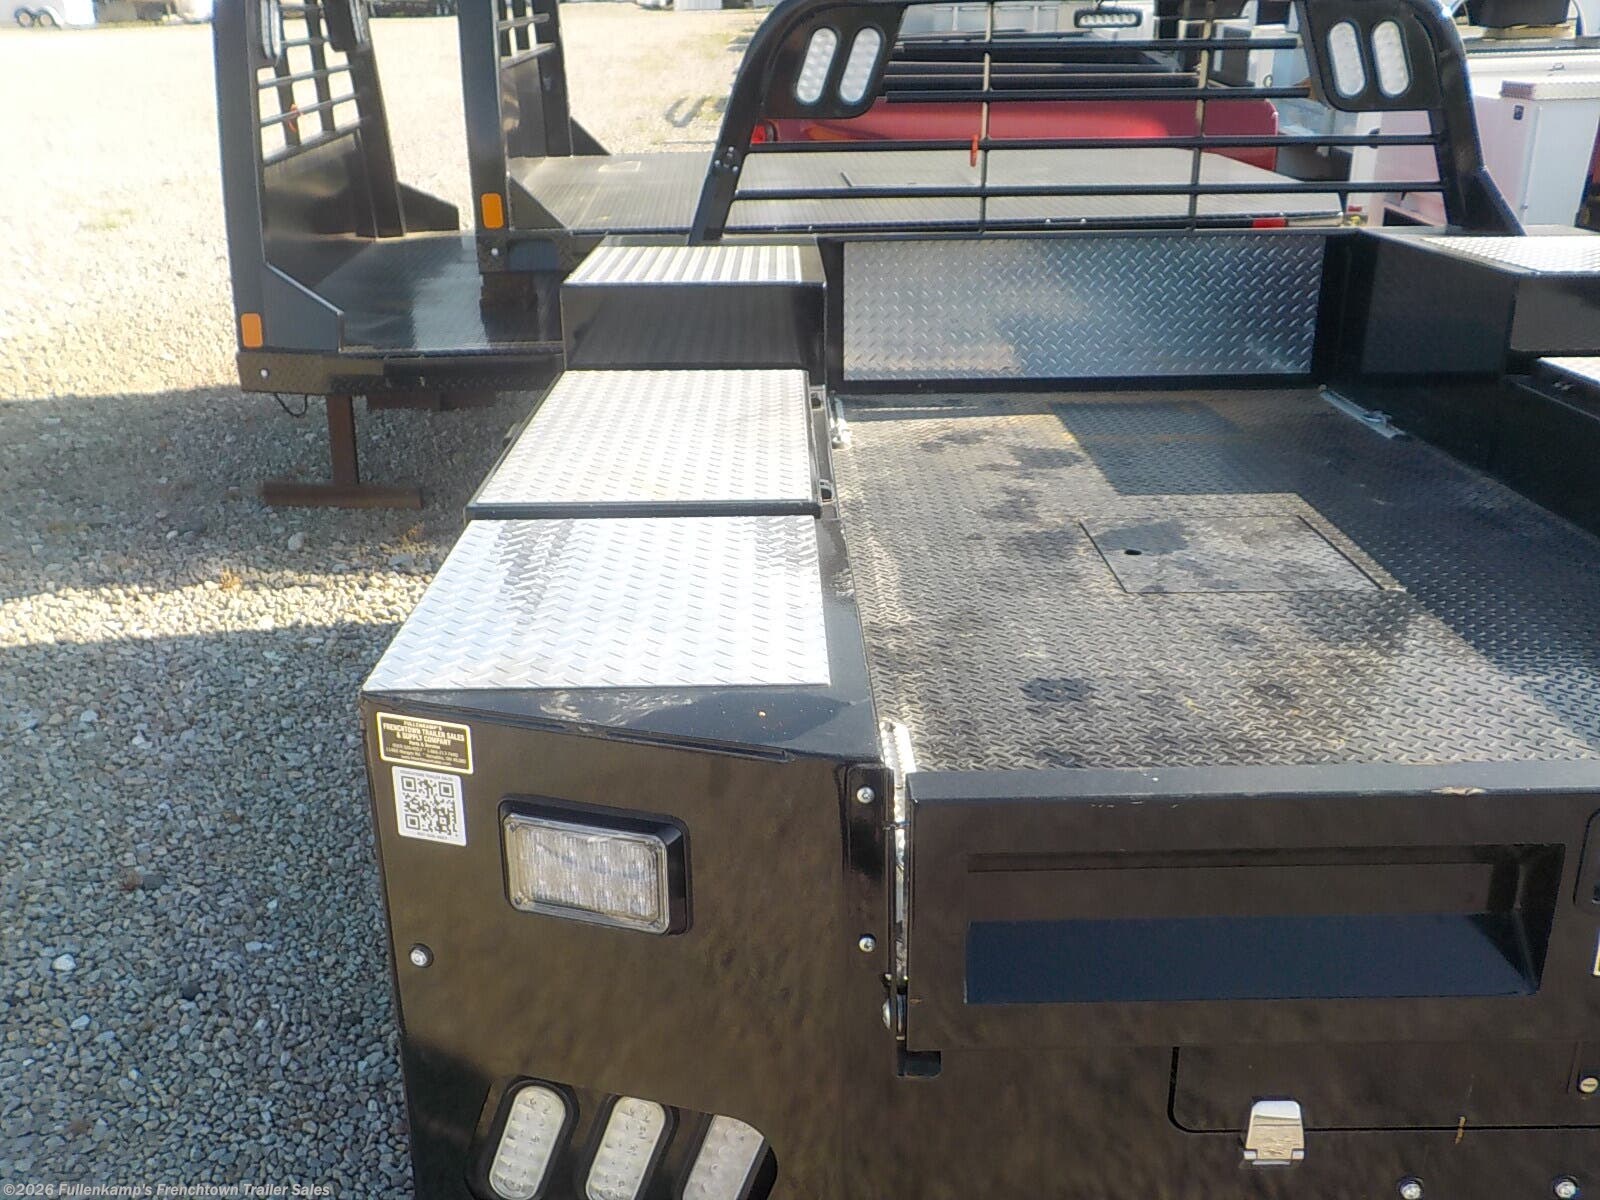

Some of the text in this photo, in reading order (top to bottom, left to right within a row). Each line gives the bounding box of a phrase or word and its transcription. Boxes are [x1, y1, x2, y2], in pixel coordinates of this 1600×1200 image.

[383, 722, 464, 741] FRENCHTOWN TRAILER SALES
[396, 731, 451, 745] & SUPPLY COMPANY
